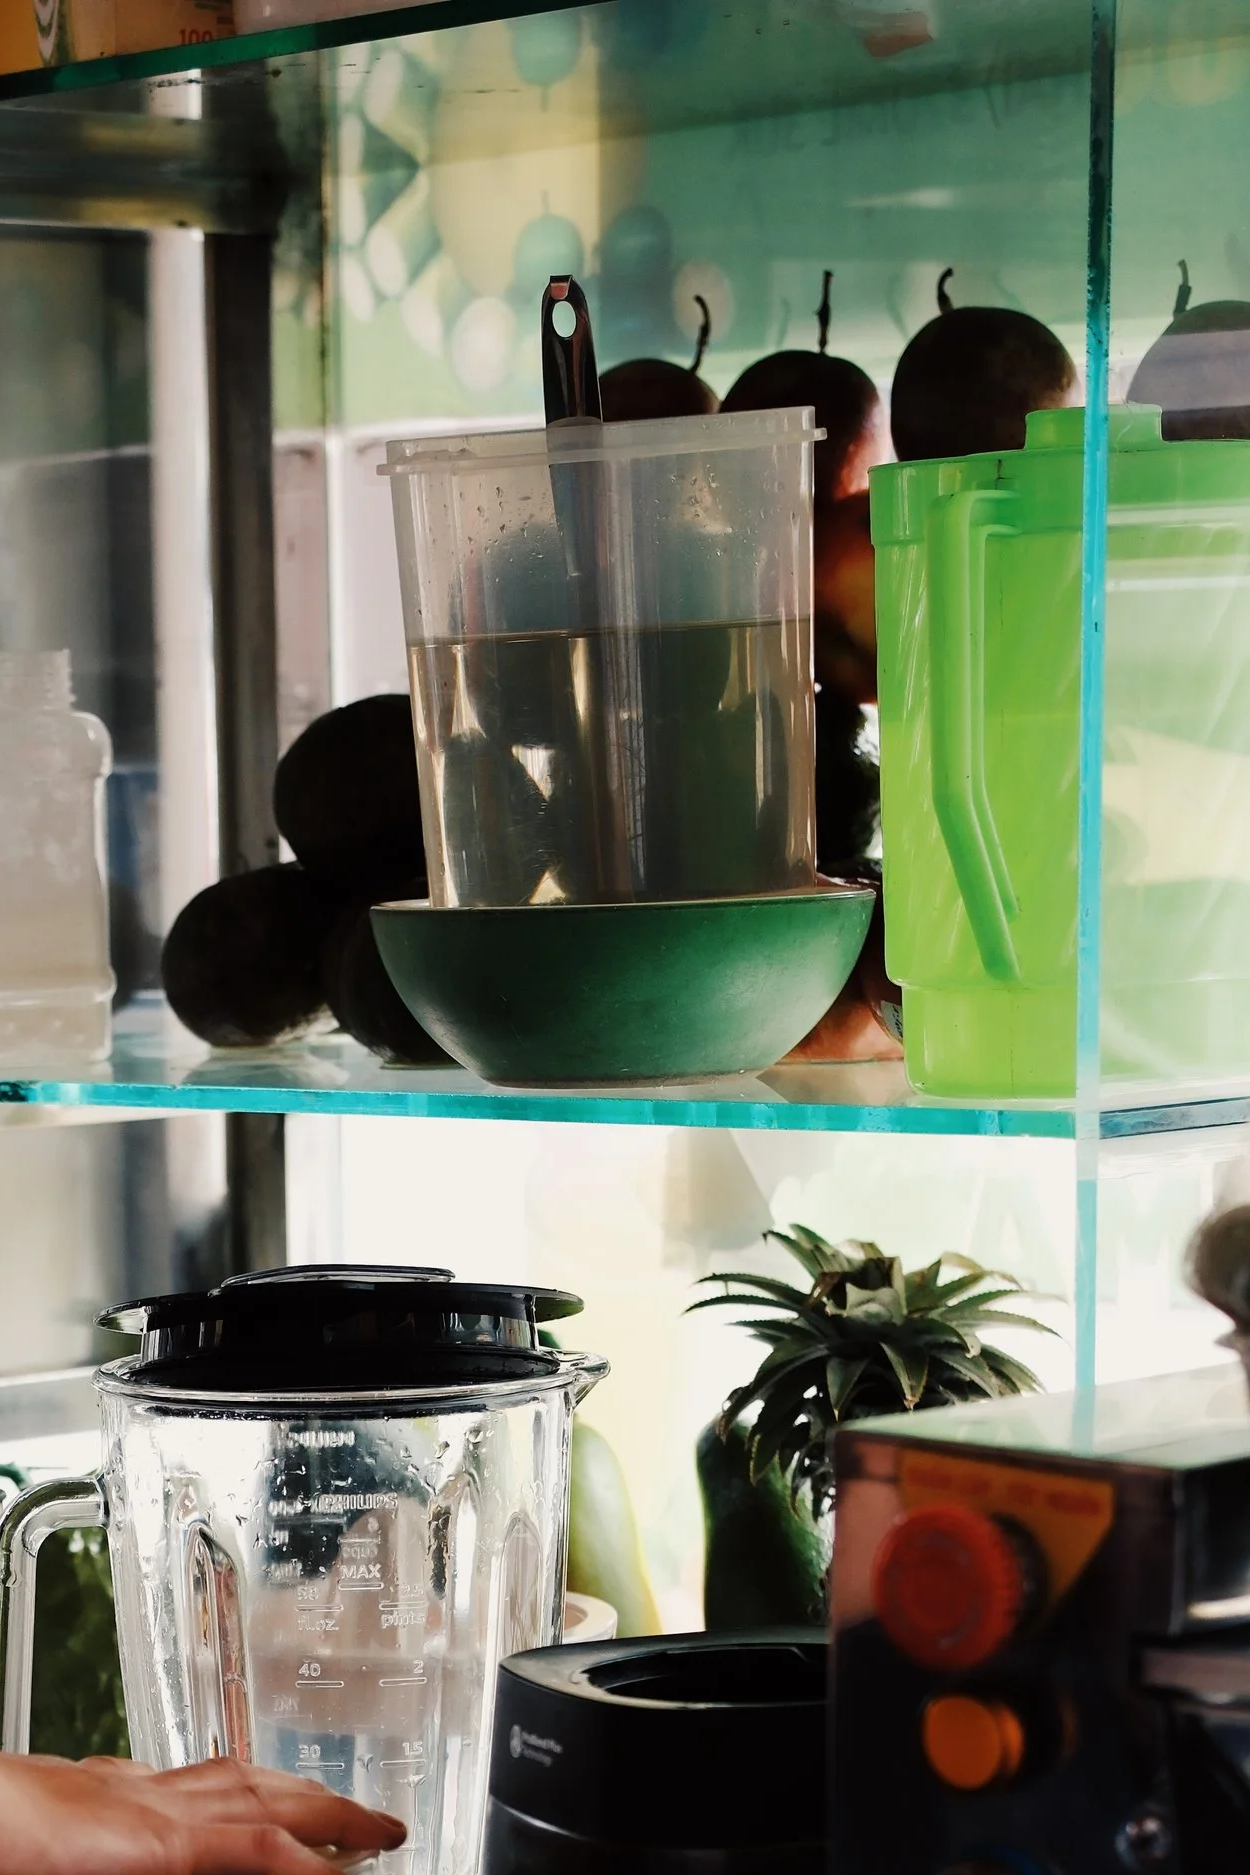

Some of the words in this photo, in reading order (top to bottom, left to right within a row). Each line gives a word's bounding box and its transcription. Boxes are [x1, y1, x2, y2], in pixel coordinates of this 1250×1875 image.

[340, 1564, 382, 1579] MAX
[381, 1611, 426, 1629] pints
[298, 1662, 321, 1677] 40
[413, 1659, 424, 1674] 2
[298, 1744, 321, 1759] 30
